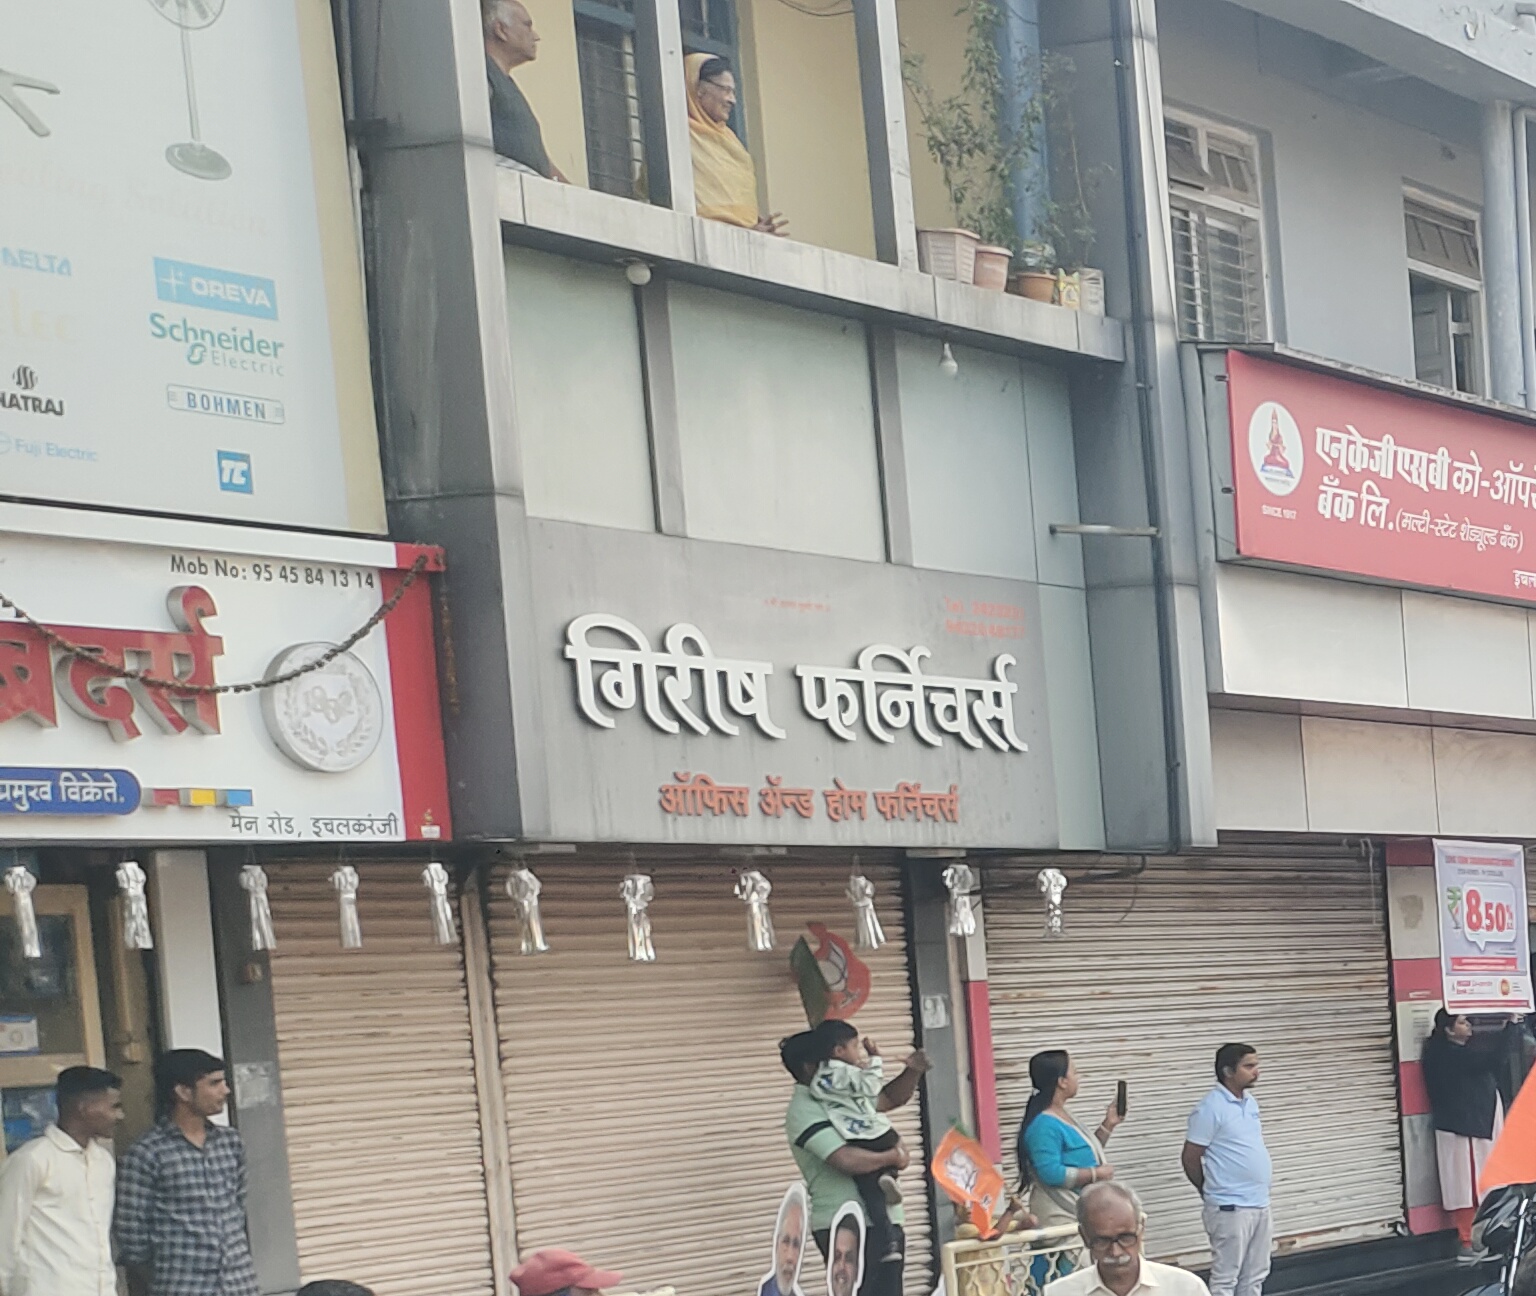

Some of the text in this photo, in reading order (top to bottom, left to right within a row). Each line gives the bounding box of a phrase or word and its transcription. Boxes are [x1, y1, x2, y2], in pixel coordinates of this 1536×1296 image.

[190, 275, 271, 308] OREVA
[149, 312, 285, 358] Schneider
[211, 352, 285, 377] Electric
[187, 391, 266, 419] BOHMEN
[15, 438, 98, 461] Fuji Electric
[1359, 479, 1395, 531] लि.
[170, 554, 374, 589] Mob No: 95 45 84 13 14
[564, 612, 1029, 752] गिरीष फर्निचर्स
[659, 771, 750, 818] ऑफिस
[824, 778, 867, 821] होम
[874, 780, 960, 823] फर्निचर्स
[312, 812, 399, 838] इचलकरंजी
